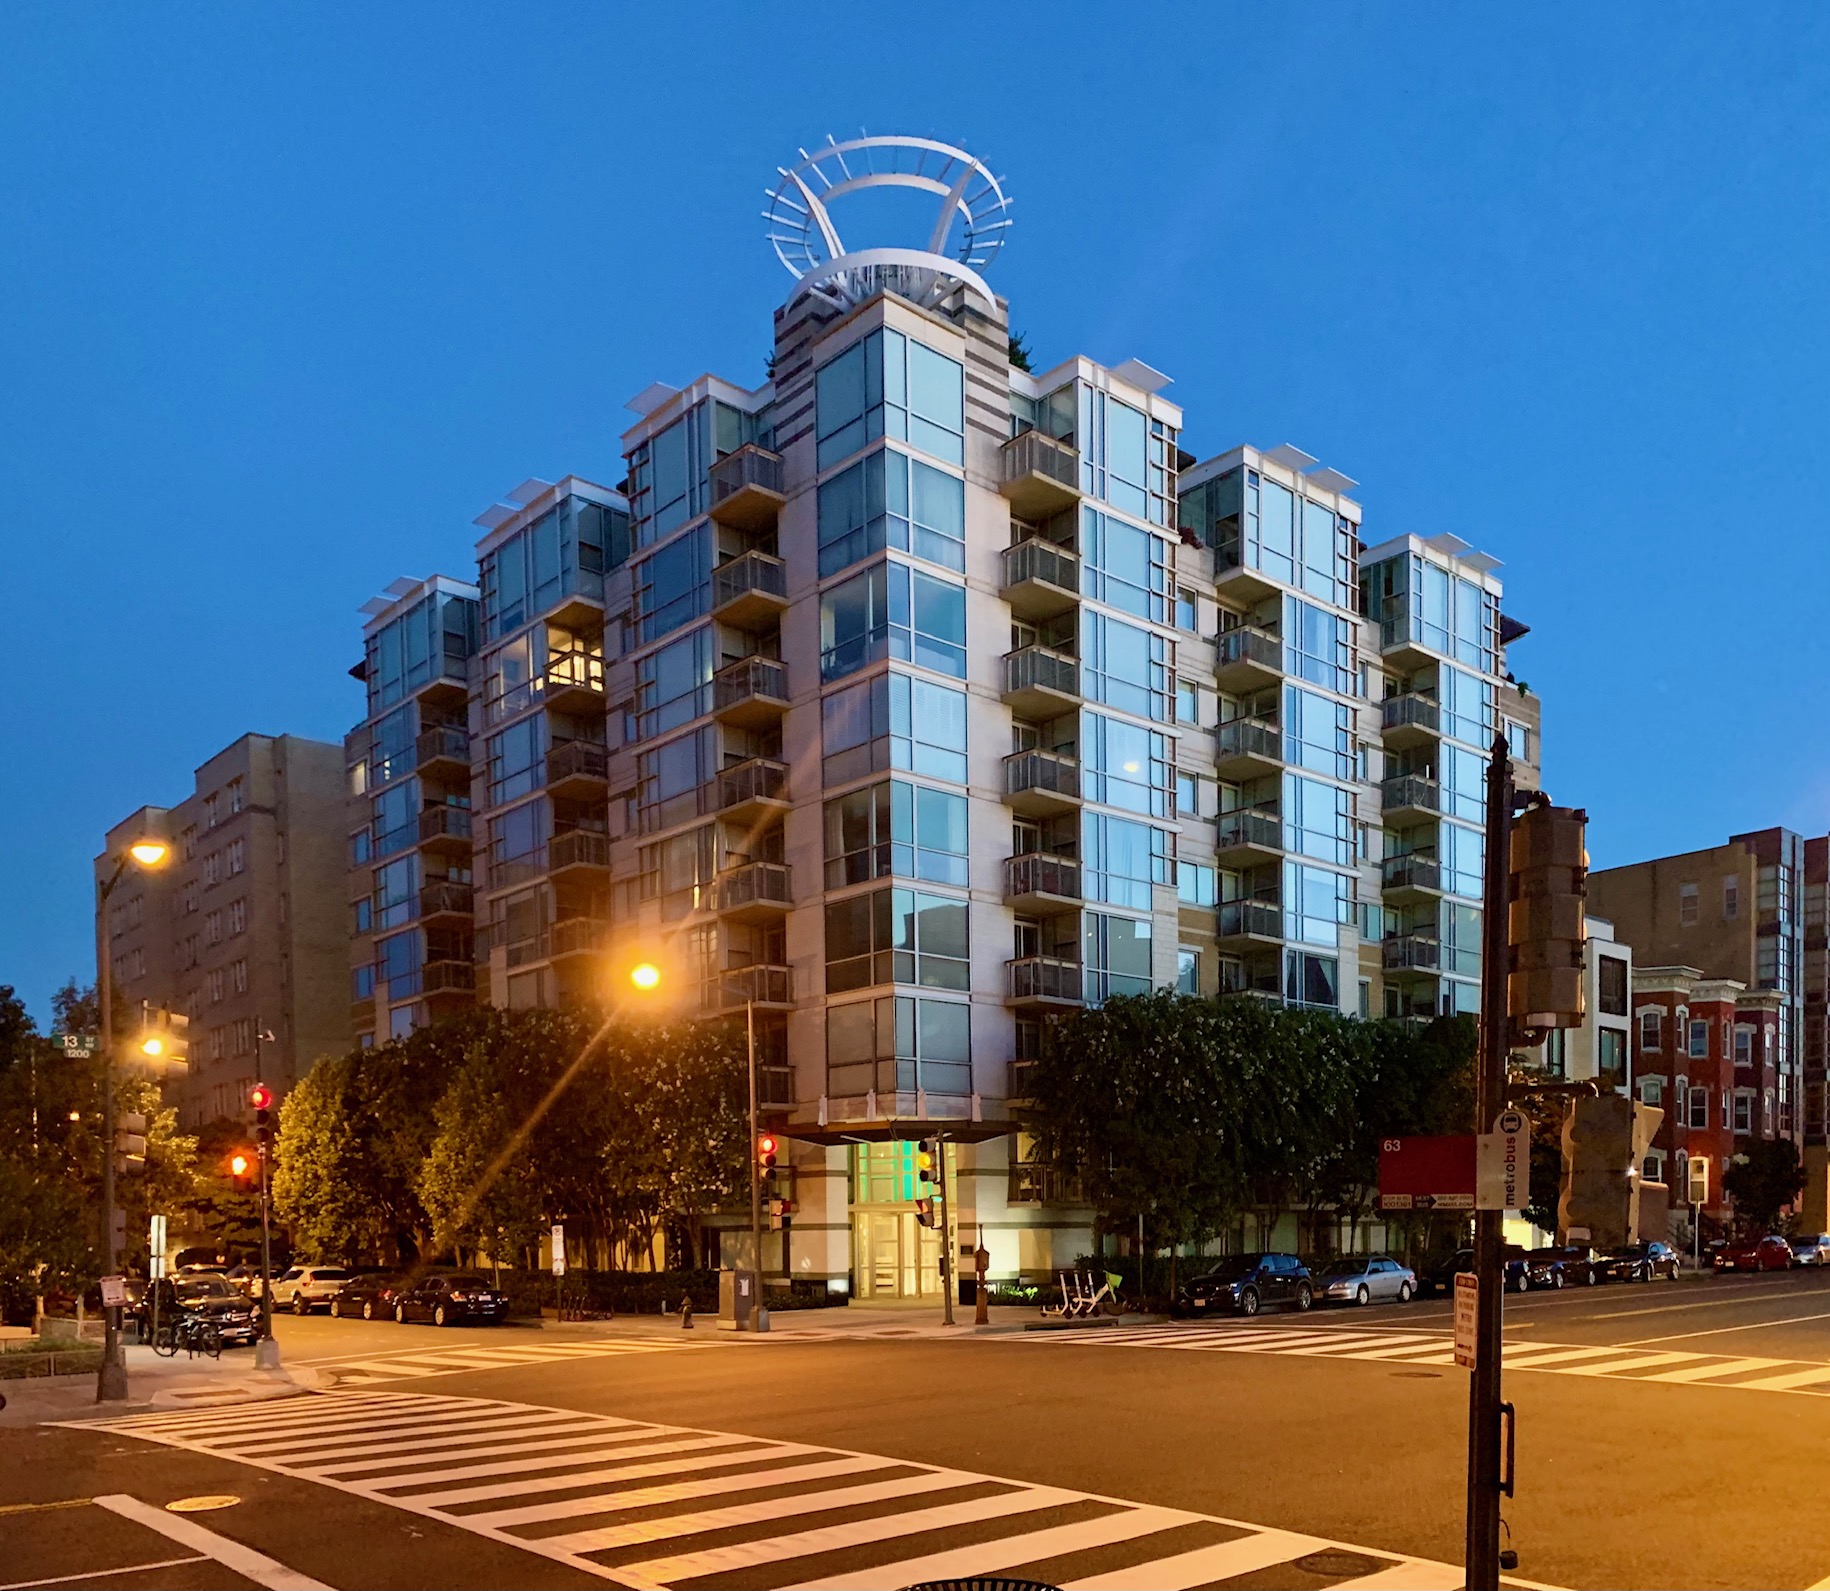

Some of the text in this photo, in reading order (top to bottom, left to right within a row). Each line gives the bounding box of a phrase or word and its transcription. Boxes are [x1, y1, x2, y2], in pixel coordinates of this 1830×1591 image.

[62, 1035, 78, 1048] 13
[67, 1049, 90, 1058] 1200
[1383, 1139, 1401, 1152] 63
[1503, 1136, 1516, 1206] metrobus
